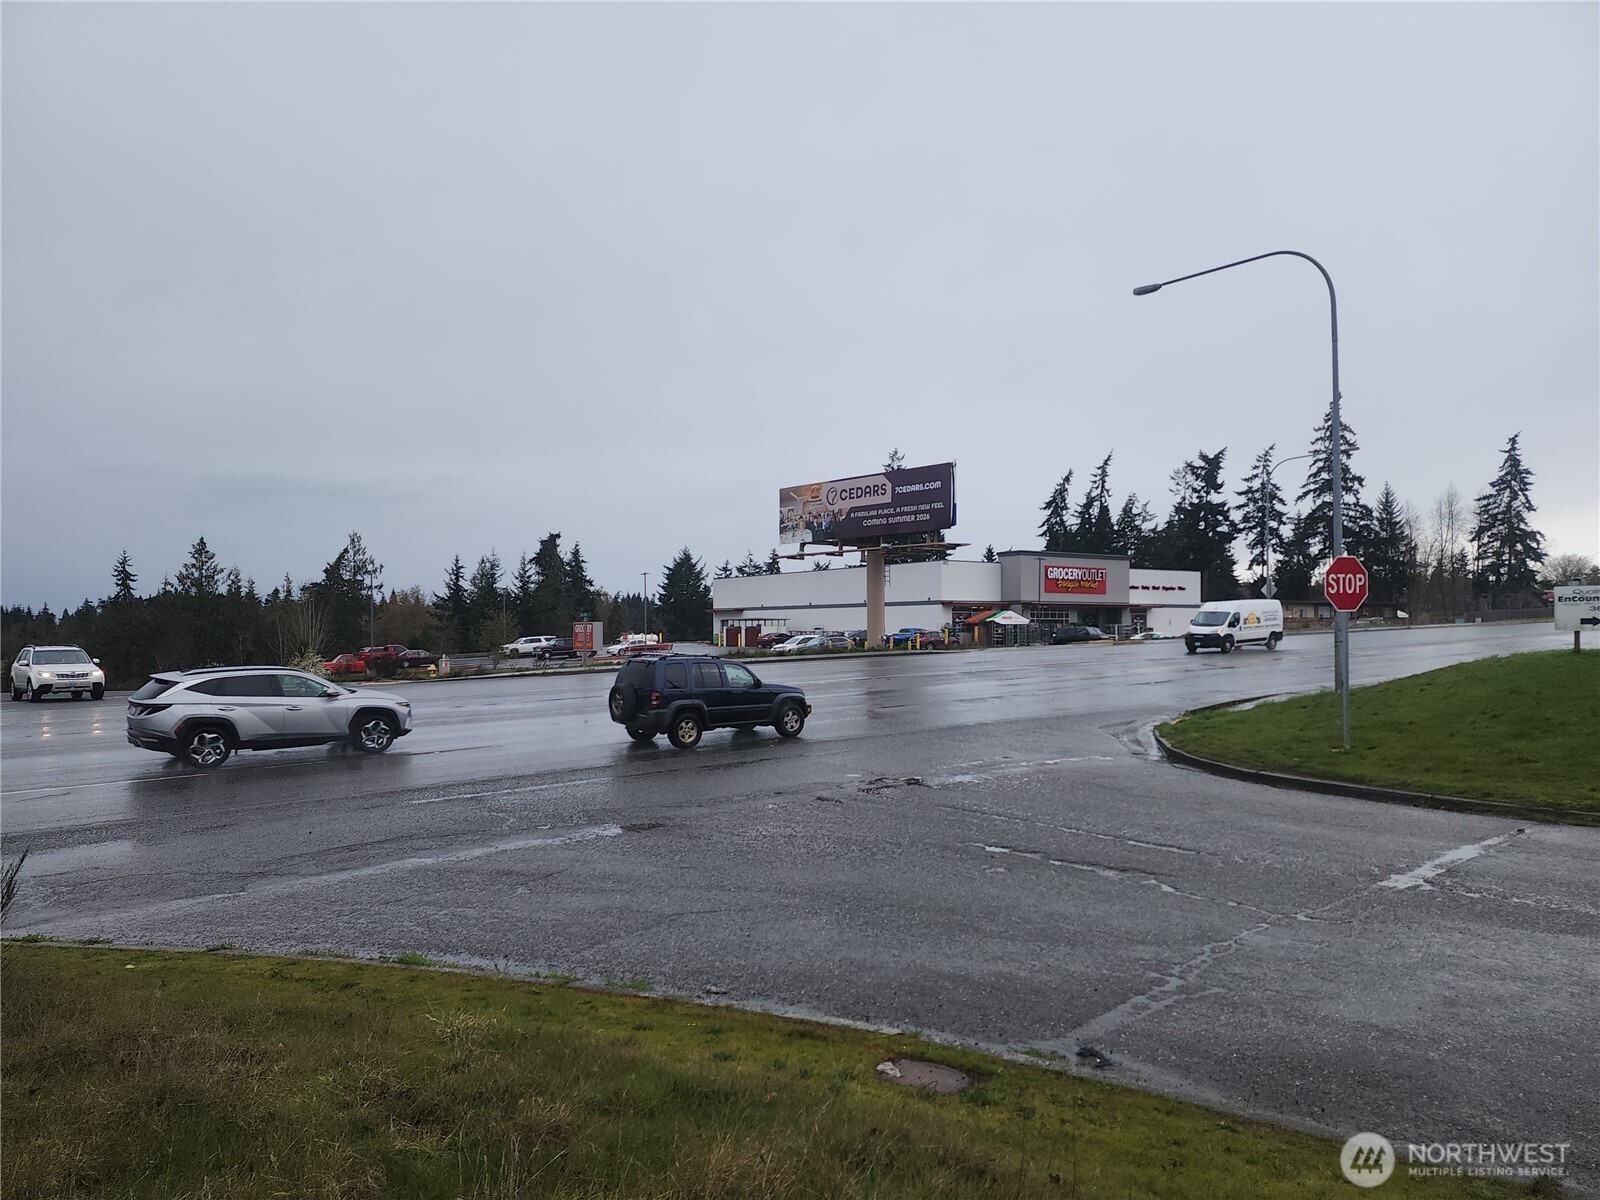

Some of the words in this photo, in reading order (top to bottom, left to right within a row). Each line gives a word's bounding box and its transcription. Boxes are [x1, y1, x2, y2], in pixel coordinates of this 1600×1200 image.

[840, 483, 887, 501] CEDARS
[895, 481, 942, 494] 7CEDARS.COM
[855, 510, 878, 518] FAMILIAR
[862, 518, 887, 526] COMING
[888, 515, 915, 524] SUMMER
[916, 513, 930, 521] 2026
[1328, 573, 1365, 594] STOP
